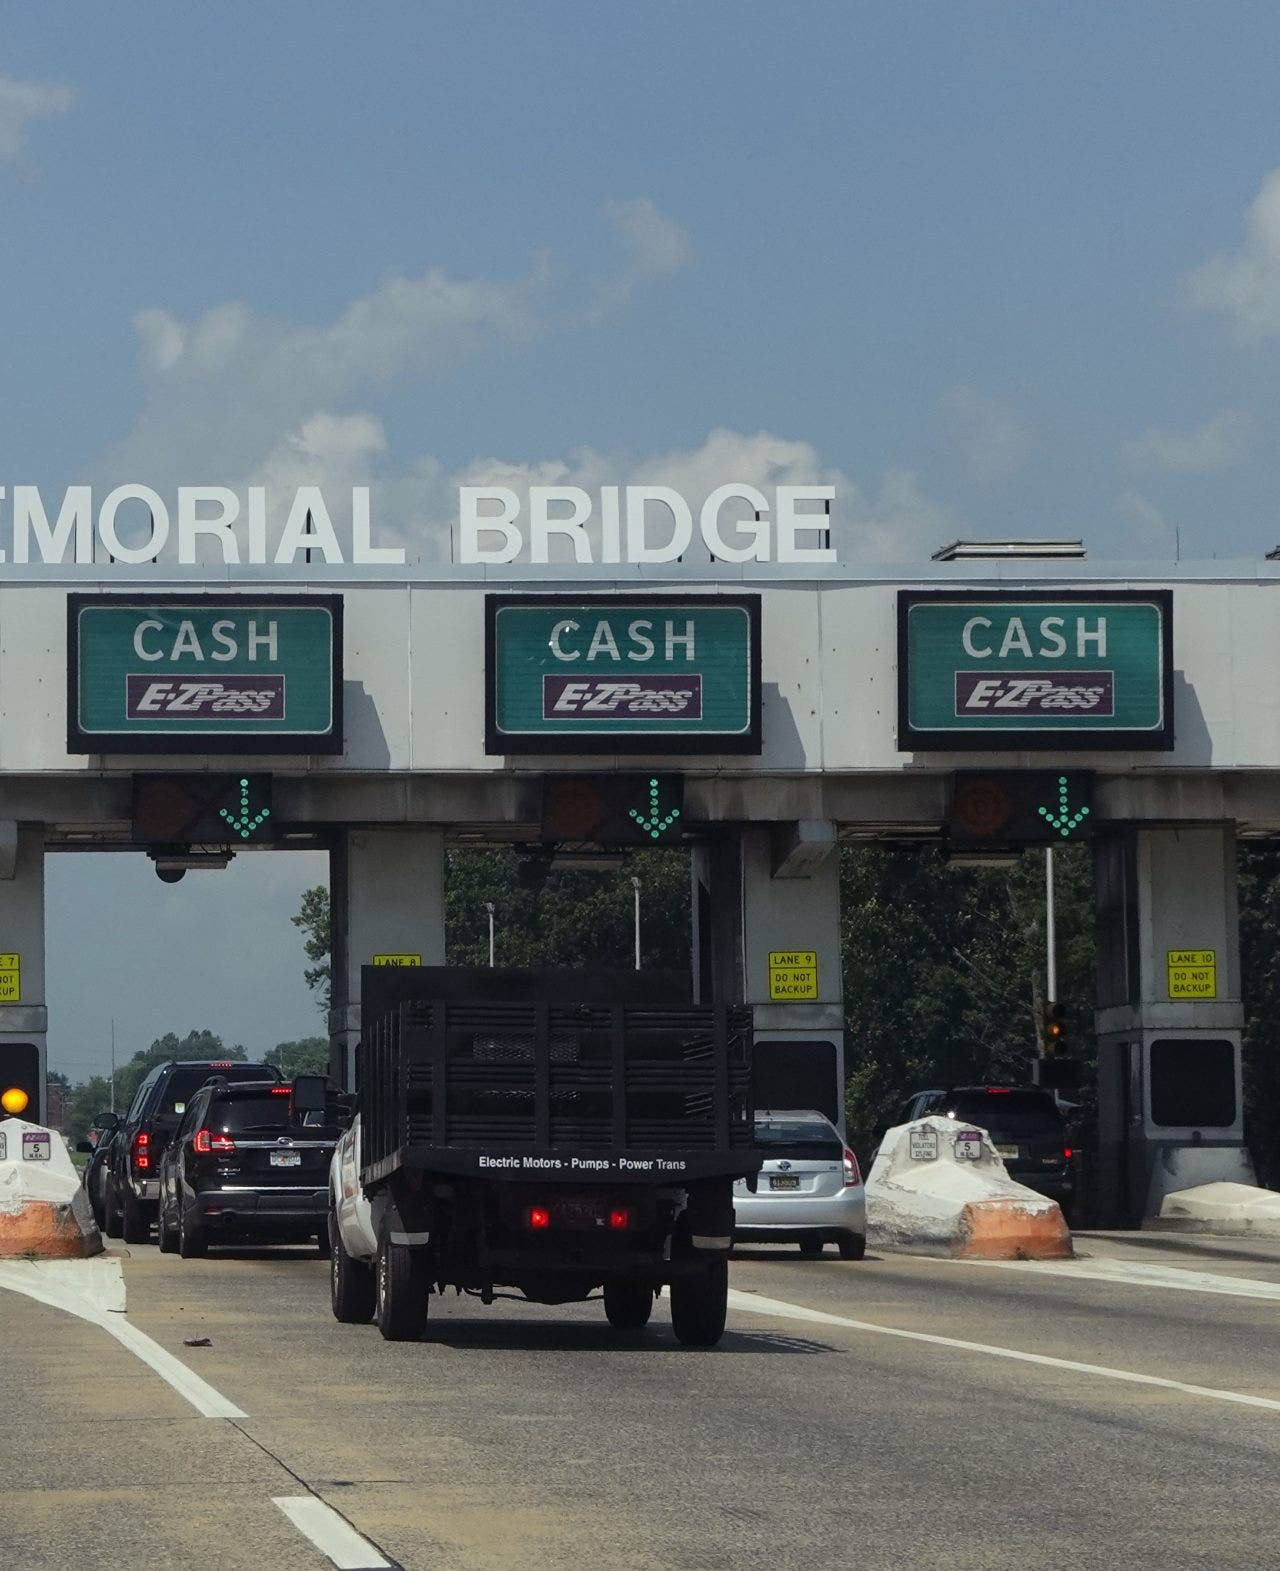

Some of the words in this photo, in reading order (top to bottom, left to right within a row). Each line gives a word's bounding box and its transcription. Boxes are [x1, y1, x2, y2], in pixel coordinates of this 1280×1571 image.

[458, 484, 838, 564] BRIDGE
[133, 619, 279, 662] CASH
[550, 619, 696, 662] CASH
[961, 616, 1108, 659] CASH
[136, 683, 276, 712] E-ZPass
[552, 683, 693, 712] E-ZPass
[965, 680, 1106, 709] E-ZPass
[8, 957, 15, 966] 7
[774, 955, 800, 965] LANE
[805, 955, 812, 965] 9
[1170, 954, 1197, 963] LANE
[1201, 954, 1213, 963] 10
[775, 973, 788, 982] DO
[793, 973, 811, 982] NOT
[1174, 972, 1187, 981] DO
[1192, 972, 1210, 981] NOT
[775, 985, 813, 994] BACKUP
[1173, 984, 1212, 993] BACKUP
[33, 1143, 40, 1153] 5
[964, 1142, 971, 1151] 5
[478, 1156, 521, 1168] Electric
[522, 1157, 562, 1169] Motors
[571, 1157, 610, 1171] Pumps
[619, 1158, 654, 1170] Power
[655, 1158, 687, 1170] Trans
